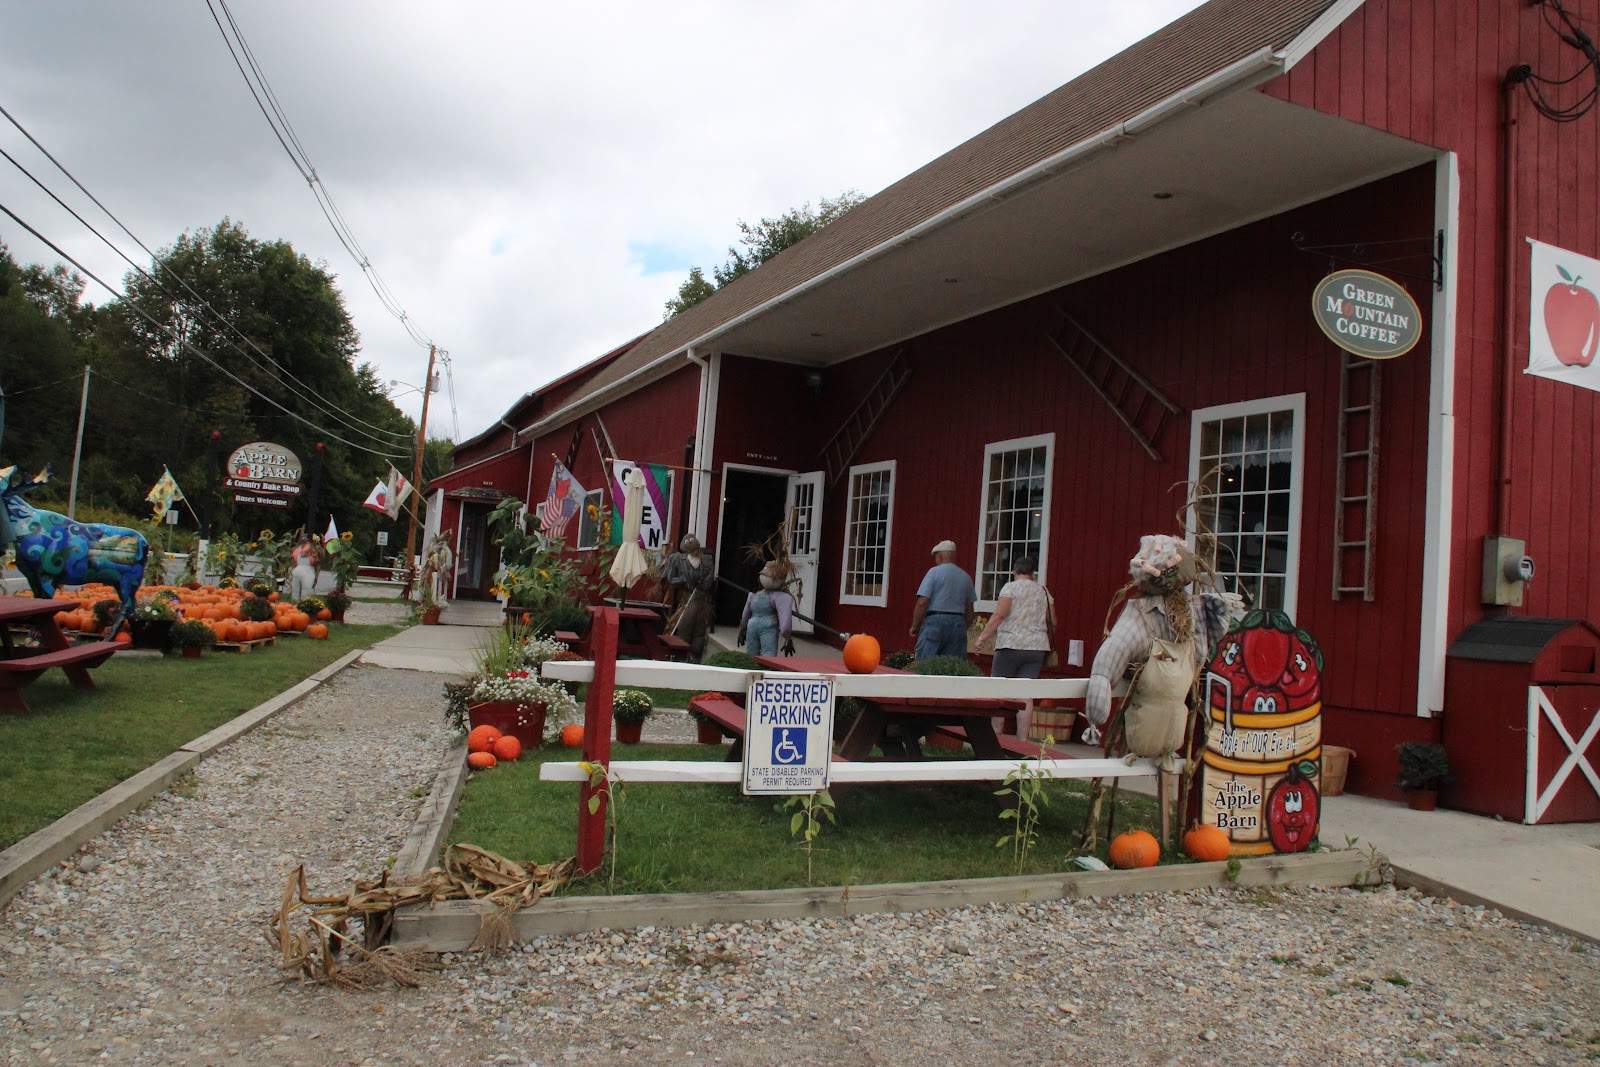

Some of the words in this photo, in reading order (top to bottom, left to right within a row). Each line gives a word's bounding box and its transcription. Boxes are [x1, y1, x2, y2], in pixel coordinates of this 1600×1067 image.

[1342, 283, 1395, 310] GREEN
[1336, 317, 1397, 345] COFFEE
[232, 449, 287, 467] APPLE
[247, 463, 298, 480] BARN
[226, 478, 233, 486] &
[234, 480, 262, 490] Country
[262, 482, 281, 492] Bake
[282, 484, 300, 494] Shop
[235, 494, 256, 503] Buses
[257, 496, 288, 506] Welcome
[621, 467, 660, 548] OEN
[754, 682, 829, 704] RESERVED
[760, 704, 821, 725] PARKING
[1218, 728, 1239, 757] Apple
[1251, 732, 1269, 753] OUR
[1270, 732, 1284, 756] Eye
[751, 767, 769, 776] STATE
[771, 767, 799, 776] DISABLED
[800, 767, 824, 776] PARKING
[762, 777, 783, 786] PERMIT
[785, 777, 812, 786] REQUIRED
[1225, 781, 1247, 793] The
[1214, 789, 1261, 810] Apple
[1216, 812, 1257, 828] Barn
